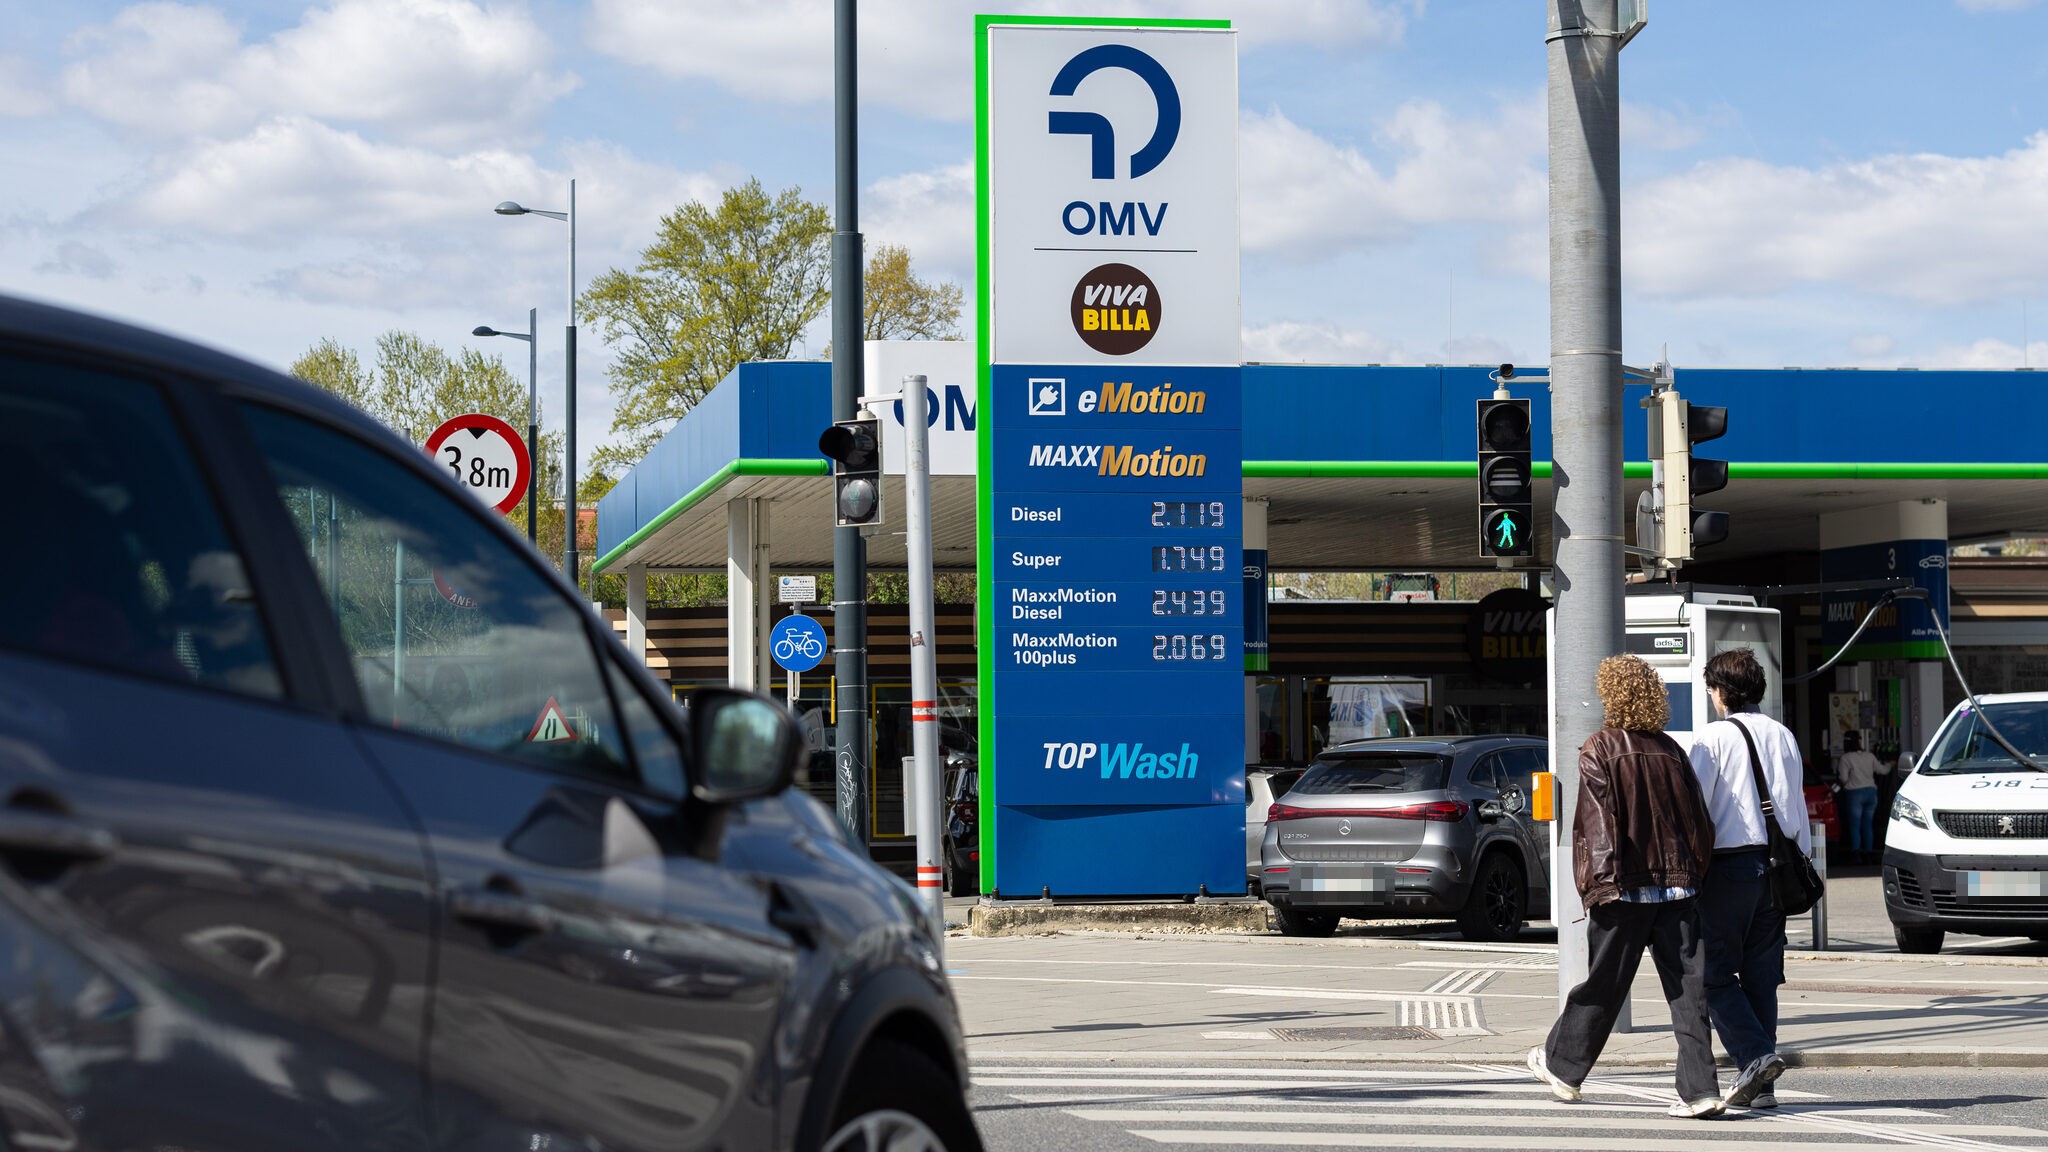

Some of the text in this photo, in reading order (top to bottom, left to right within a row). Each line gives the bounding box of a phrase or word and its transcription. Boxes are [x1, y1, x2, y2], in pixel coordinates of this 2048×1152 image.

[1062, 200, 1169, 237] OMV
[1083, 283, 1148, 308] VIVA
[1082, 308, 1151, 332] BILLA
[893, 384, 977, 431] OM
[1078, 382, 1206, 414] eMotion
[1011, 501, 1224, 527] Diesel 2.119
[1012, 546, 1225, 571] Super 1.749
[1888, 548, 1896, 570] 3
[1012, 588, 1117, 603] MaxxMotion
[1012, 590, 1225, 620] Diesel 2.439
[1483, 610, 1546, 633] VIVA
[1828, 601, 1897, 628] MAXXMtion
[1012, 633, 1118, 647] MaxxMotion
[1013, 635, 1226, 667] 100plus 2.069
[1482, 635, 1546, 659] BILLA
